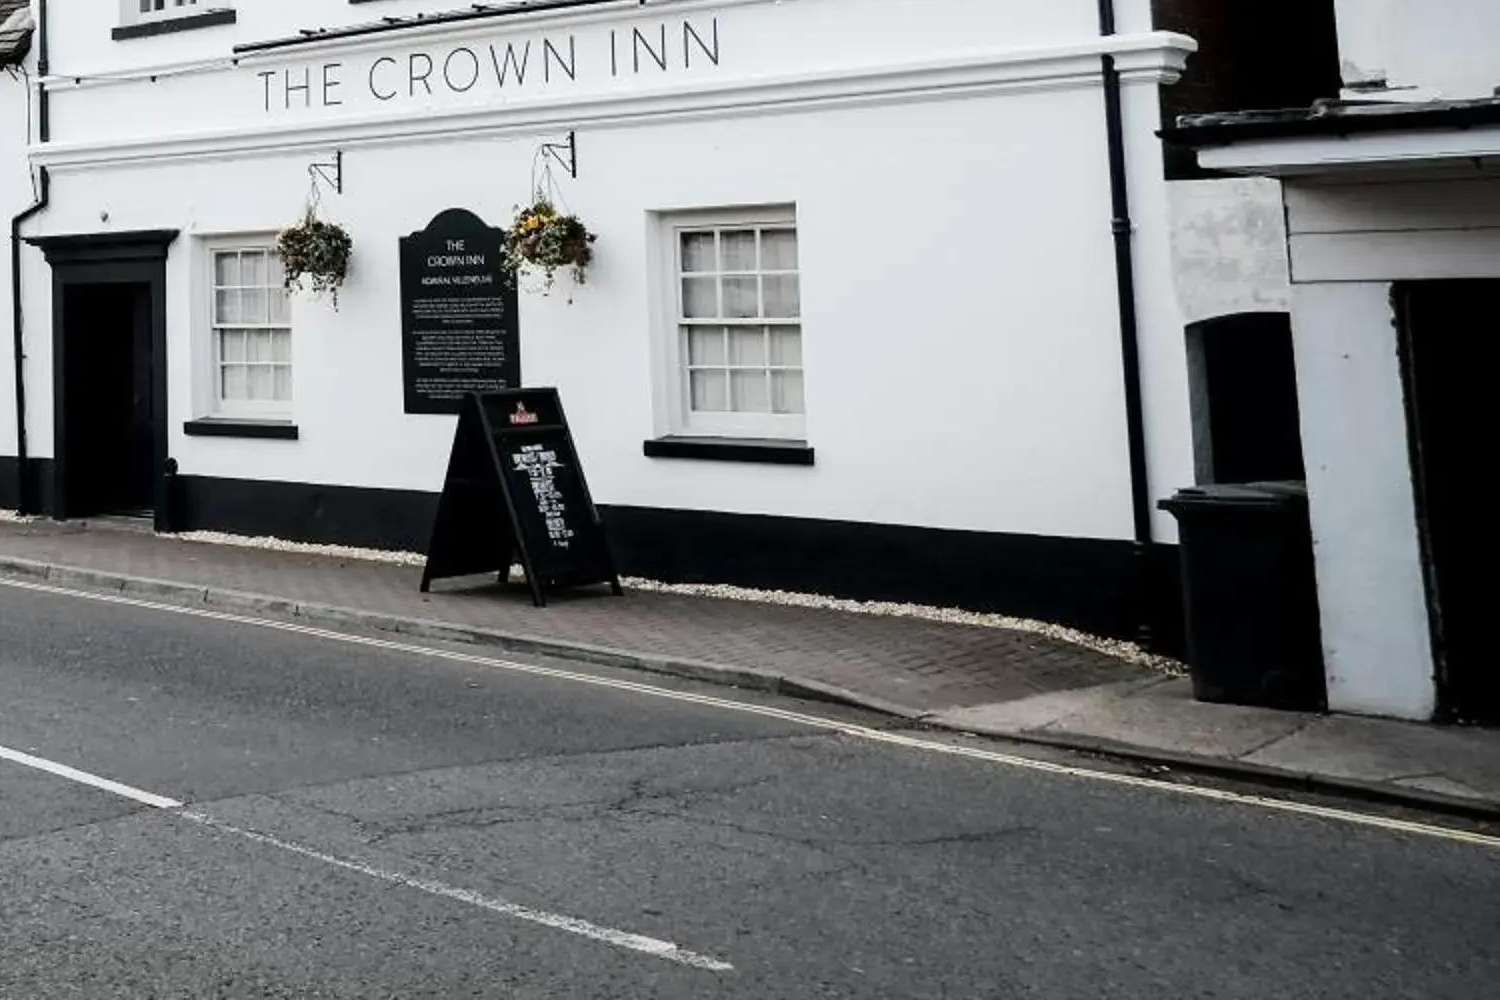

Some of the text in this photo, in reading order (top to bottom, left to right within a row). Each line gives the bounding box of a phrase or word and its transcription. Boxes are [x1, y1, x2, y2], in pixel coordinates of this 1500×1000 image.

[257, 16, 720, 112] THE CROWN INN
[446, 239, 465, 251] THE
